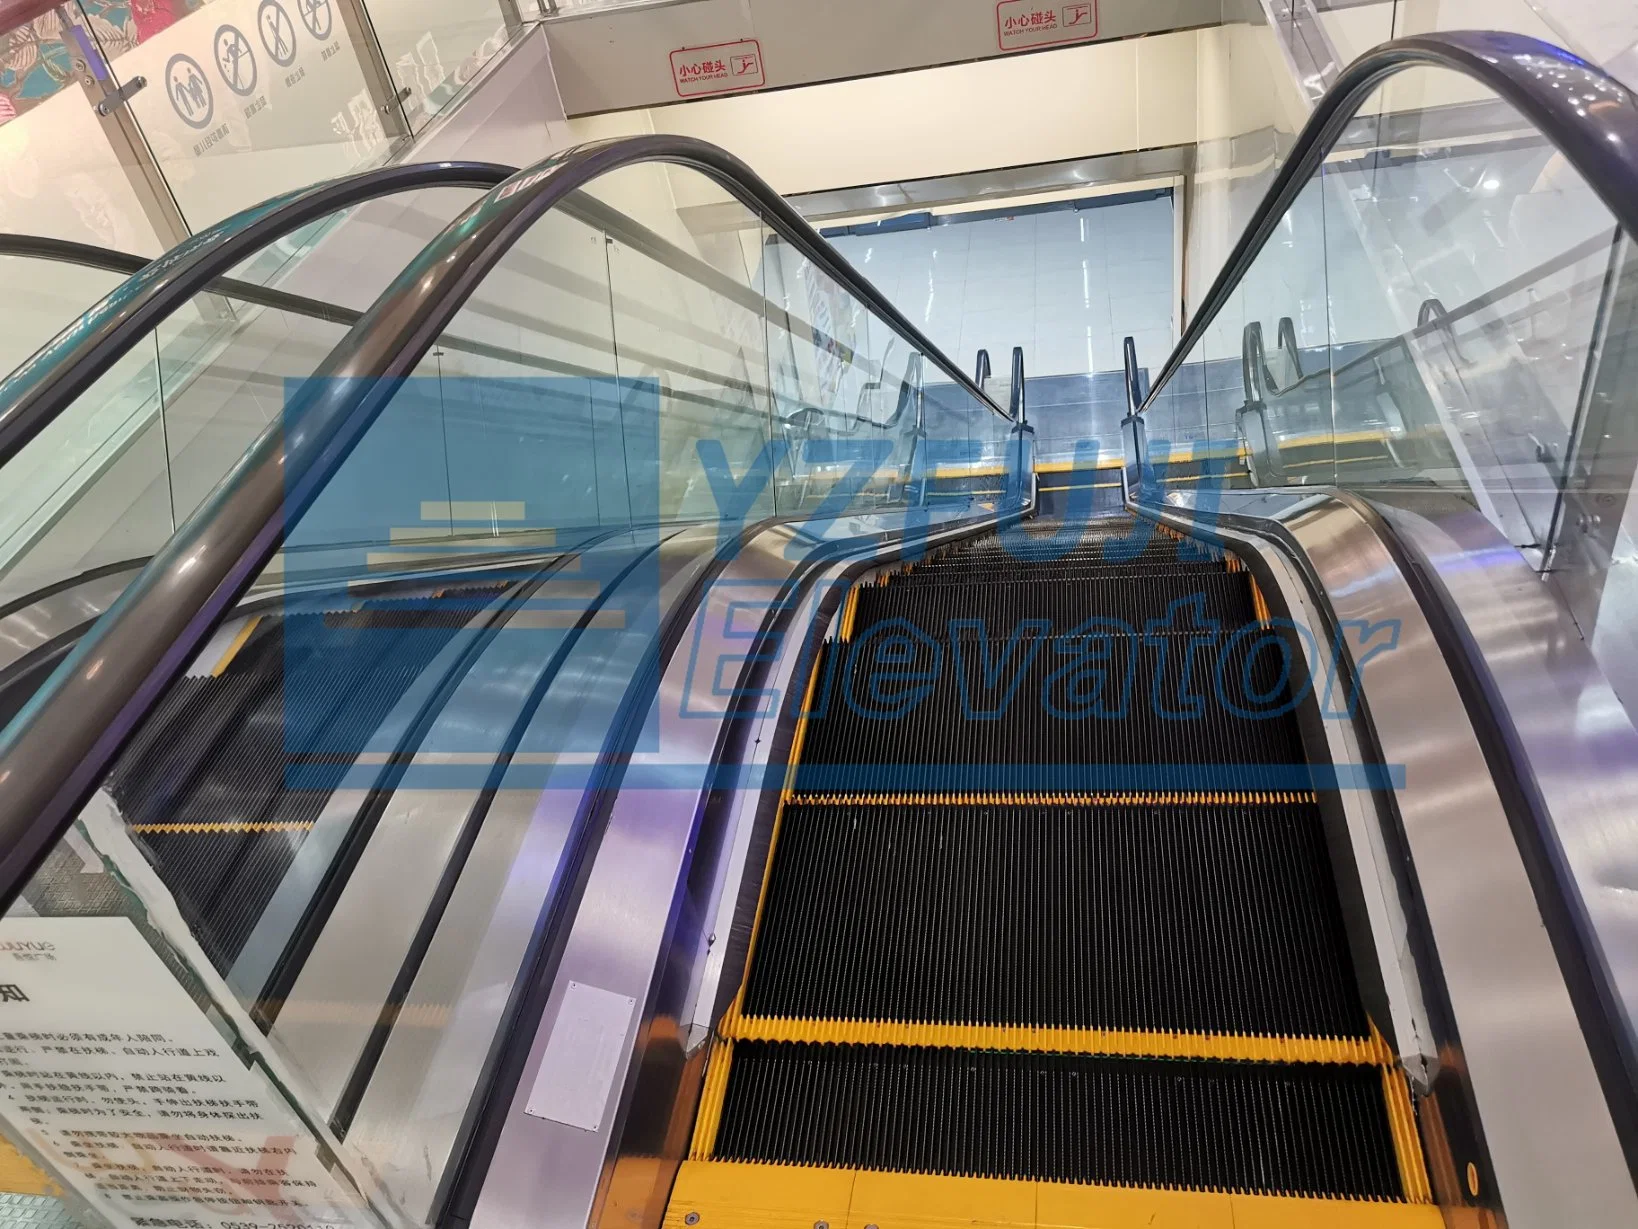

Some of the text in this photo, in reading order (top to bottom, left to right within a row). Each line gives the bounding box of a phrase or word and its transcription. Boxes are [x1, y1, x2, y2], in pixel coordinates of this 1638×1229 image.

[1004, 10, 1056, 29] 小心碰头
[680, 59, 727, 77] 小心碰头
[680, 72, 728, 84] WATCH YOUR HEAD
[0, 1032, 173, 1043] 童乘梯时必须有成年人陪同。
